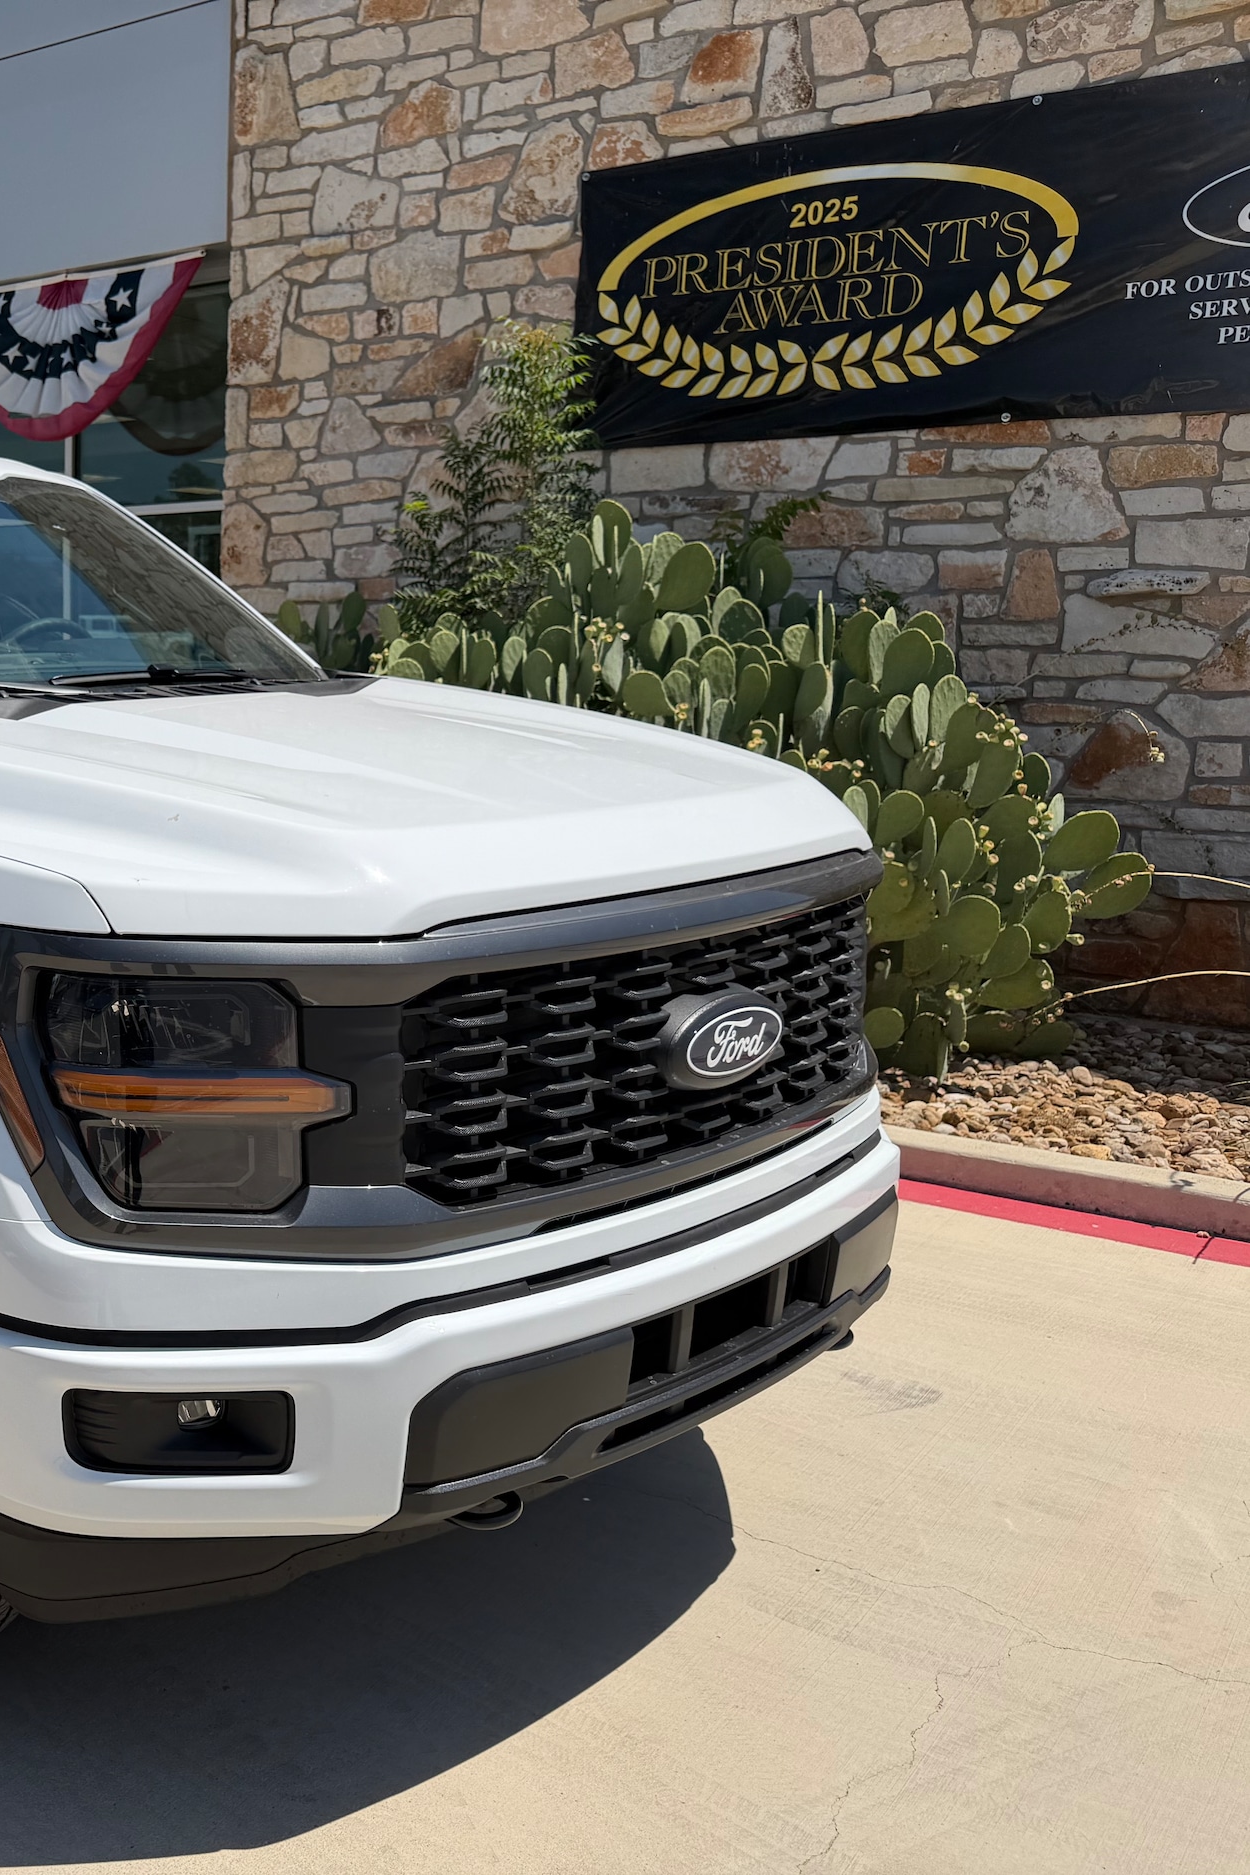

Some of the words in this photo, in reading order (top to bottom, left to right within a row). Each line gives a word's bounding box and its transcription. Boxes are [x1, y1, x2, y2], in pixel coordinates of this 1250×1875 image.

[789, 195, 859, 228] 2025
[640, 210, 1031, 299] PRESIDENT'S
[713, 272, 923, 334] AWARD
[1124, 278, 1177, 300] FOR
[1184, 268, 1250, 293] OUTS
[706, 1016, 767, 1068] Ford
